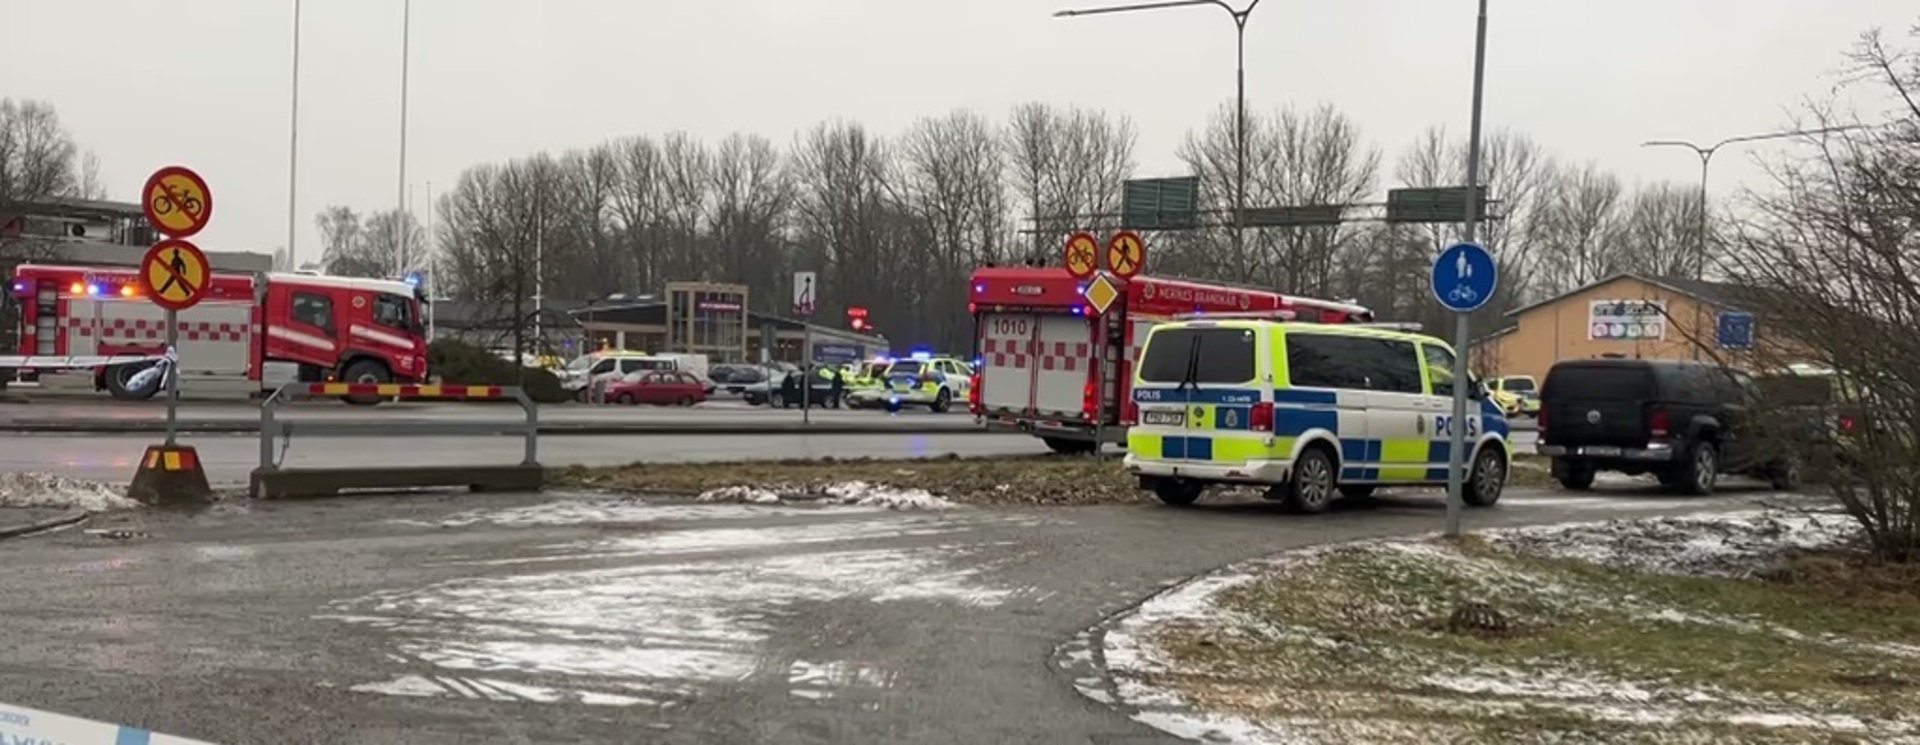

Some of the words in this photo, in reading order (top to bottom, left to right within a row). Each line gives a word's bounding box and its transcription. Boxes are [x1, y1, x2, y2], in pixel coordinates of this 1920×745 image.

[994, 319, 1027, 336] 1010
[1136, 389, 1161, 400] POLIS
[1434, 416, 1476, 437] POIS
